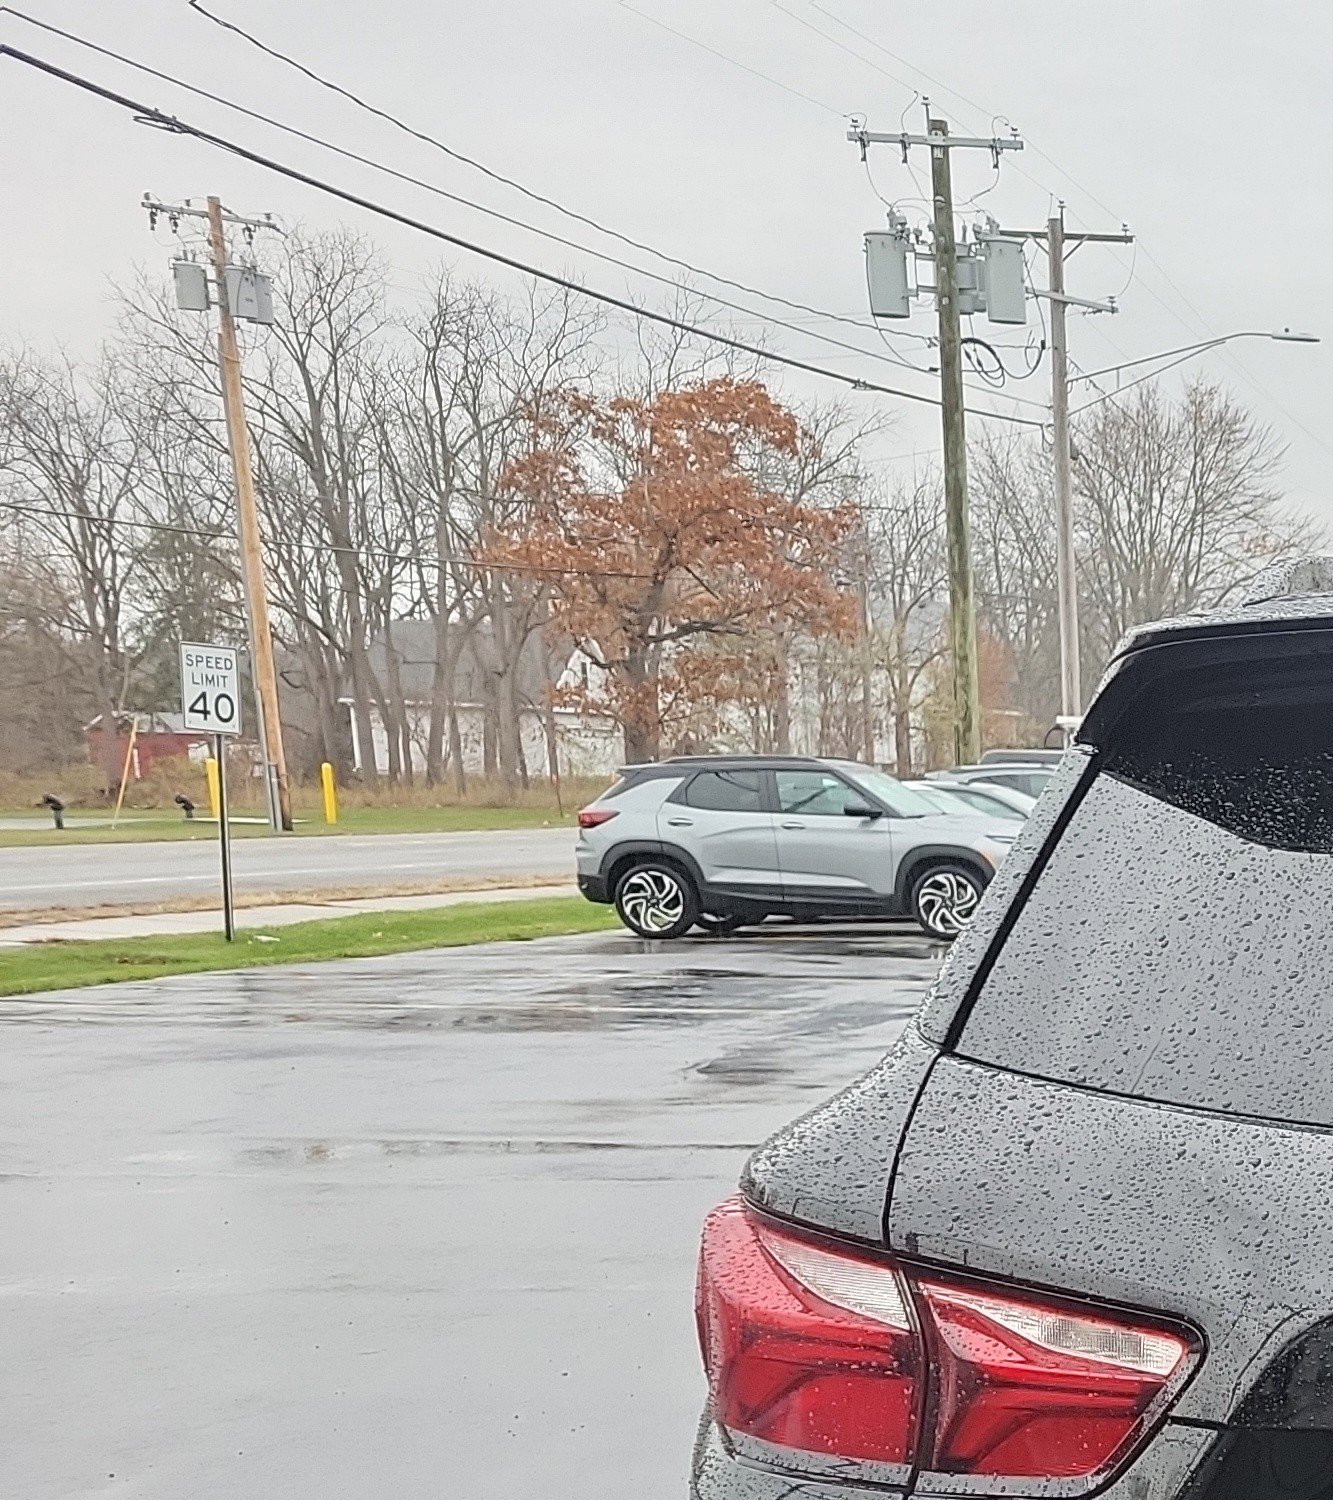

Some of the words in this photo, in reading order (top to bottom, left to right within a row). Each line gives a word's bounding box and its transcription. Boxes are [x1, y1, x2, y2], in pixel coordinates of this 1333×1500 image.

[185, 653, 233, 671] SPEED
[192, 672, 229, 688] LIMIT
[188, 691, 235, 724] 40
